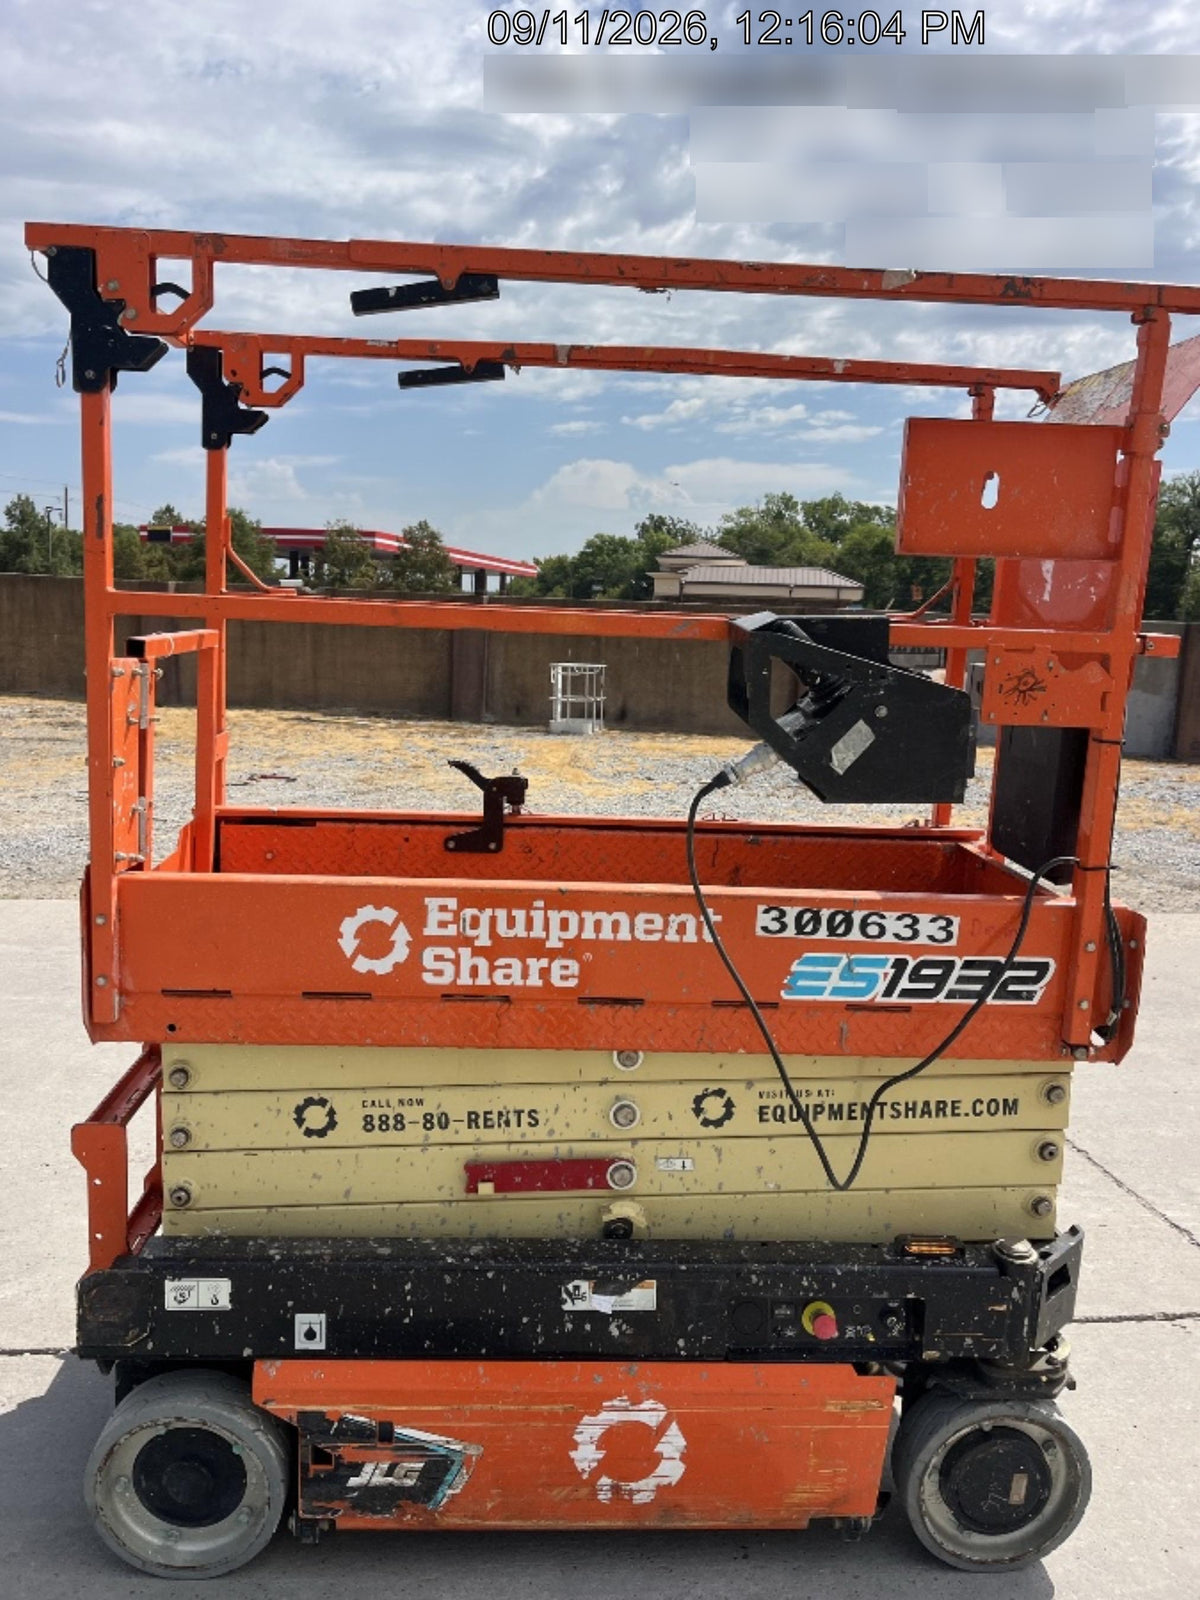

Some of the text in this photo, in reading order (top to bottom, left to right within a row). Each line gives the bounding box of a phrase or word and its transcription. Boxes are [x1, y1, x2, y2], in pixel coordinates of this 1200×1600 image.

[423, 897, 722, 949] Equipment
[760, 906, 955, 944] 300633
[422, 947, 580, 988] Share
[783, 954, 1054, 1003] ES1932
[362, 1098, 424, 1108] CALL NOW
[758, 1097, 1020, 1124] EQUIPMENTSHARE.COM
[362, 1109, 540, 1133] 888-80-RENTS
[346, 1460, 426, 1487] JLG
